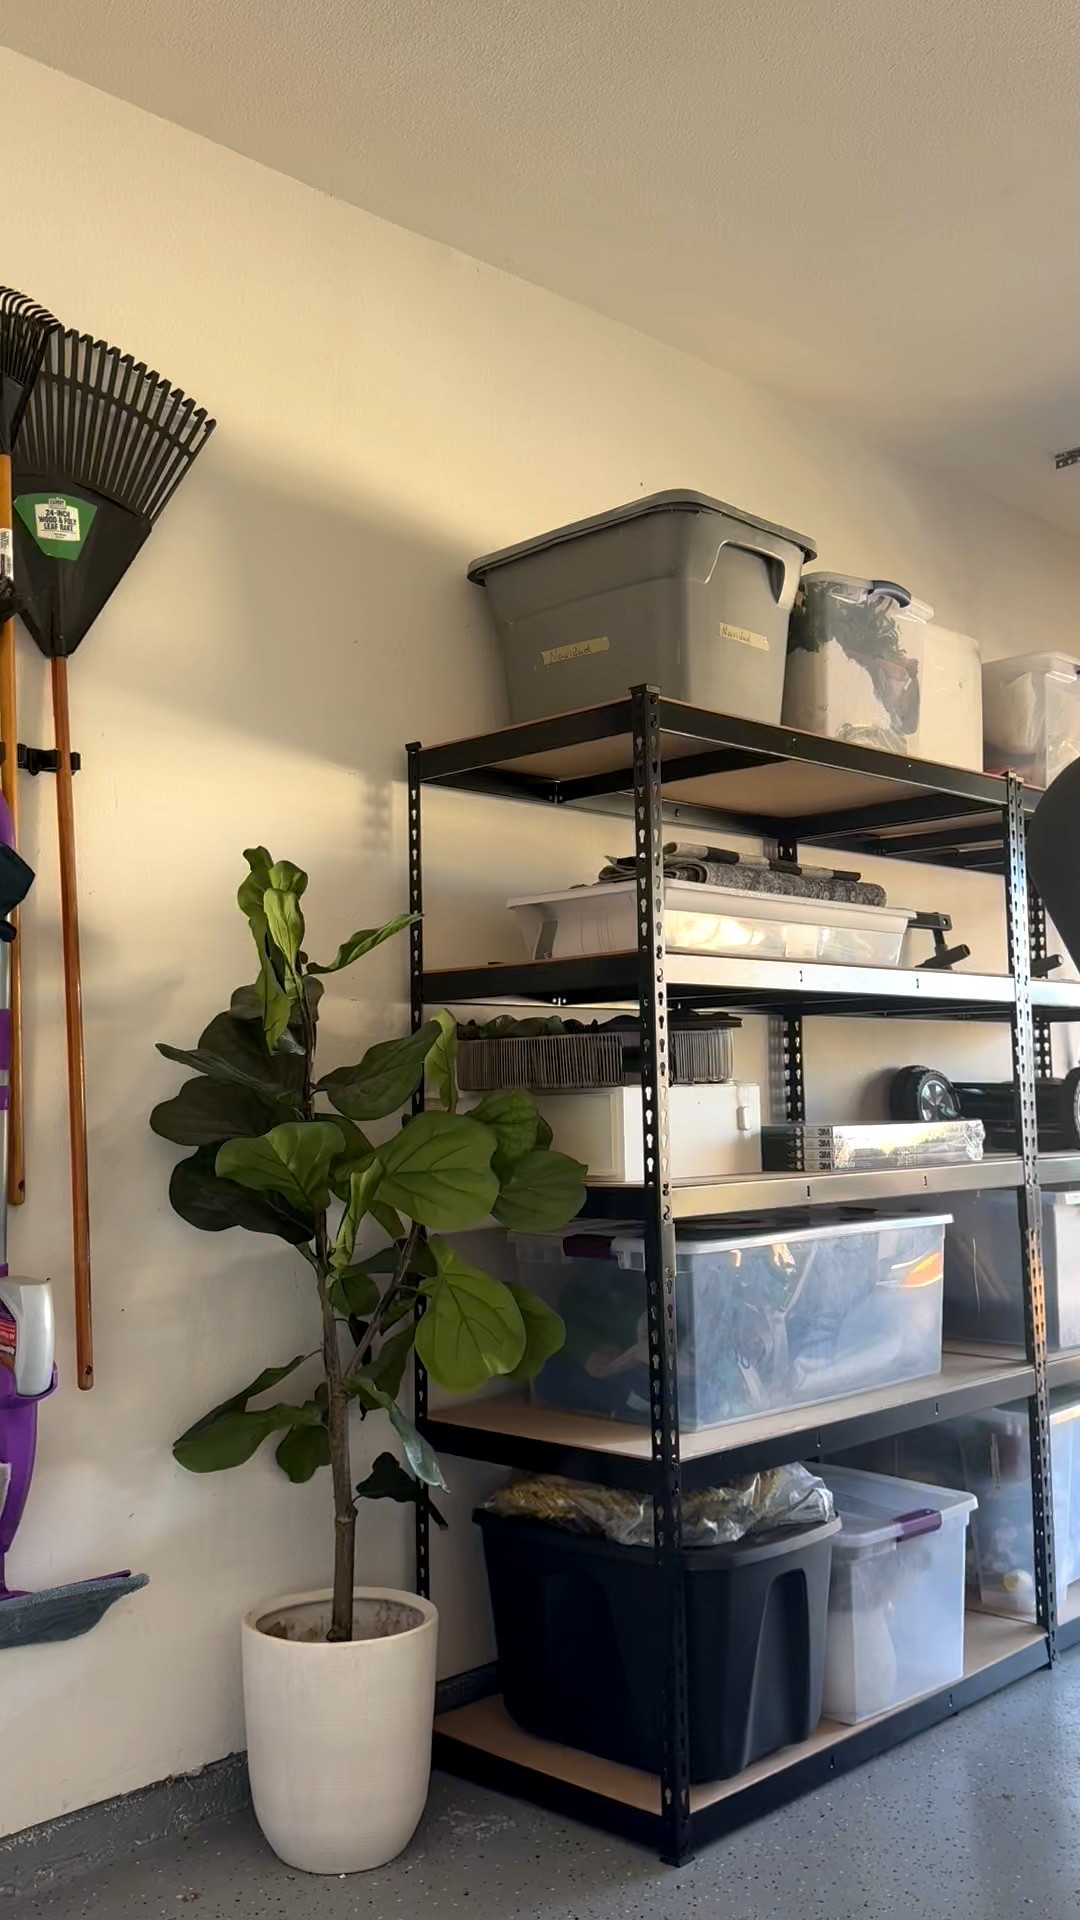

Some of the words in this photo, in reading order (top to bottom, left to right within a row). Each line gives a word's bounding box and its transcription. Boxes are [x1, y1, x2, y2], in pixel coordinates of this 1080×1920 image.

[46, 509, 70, 517] 24-INCH
[550, 643, 592, 661] Navidad
[818, 1128, 830, 1136] 3M
[818, 1139, 830, 1147] 3M
[819, 1151, 831, 1159] 3M
[819, 1162, 831, 1170] 3M
